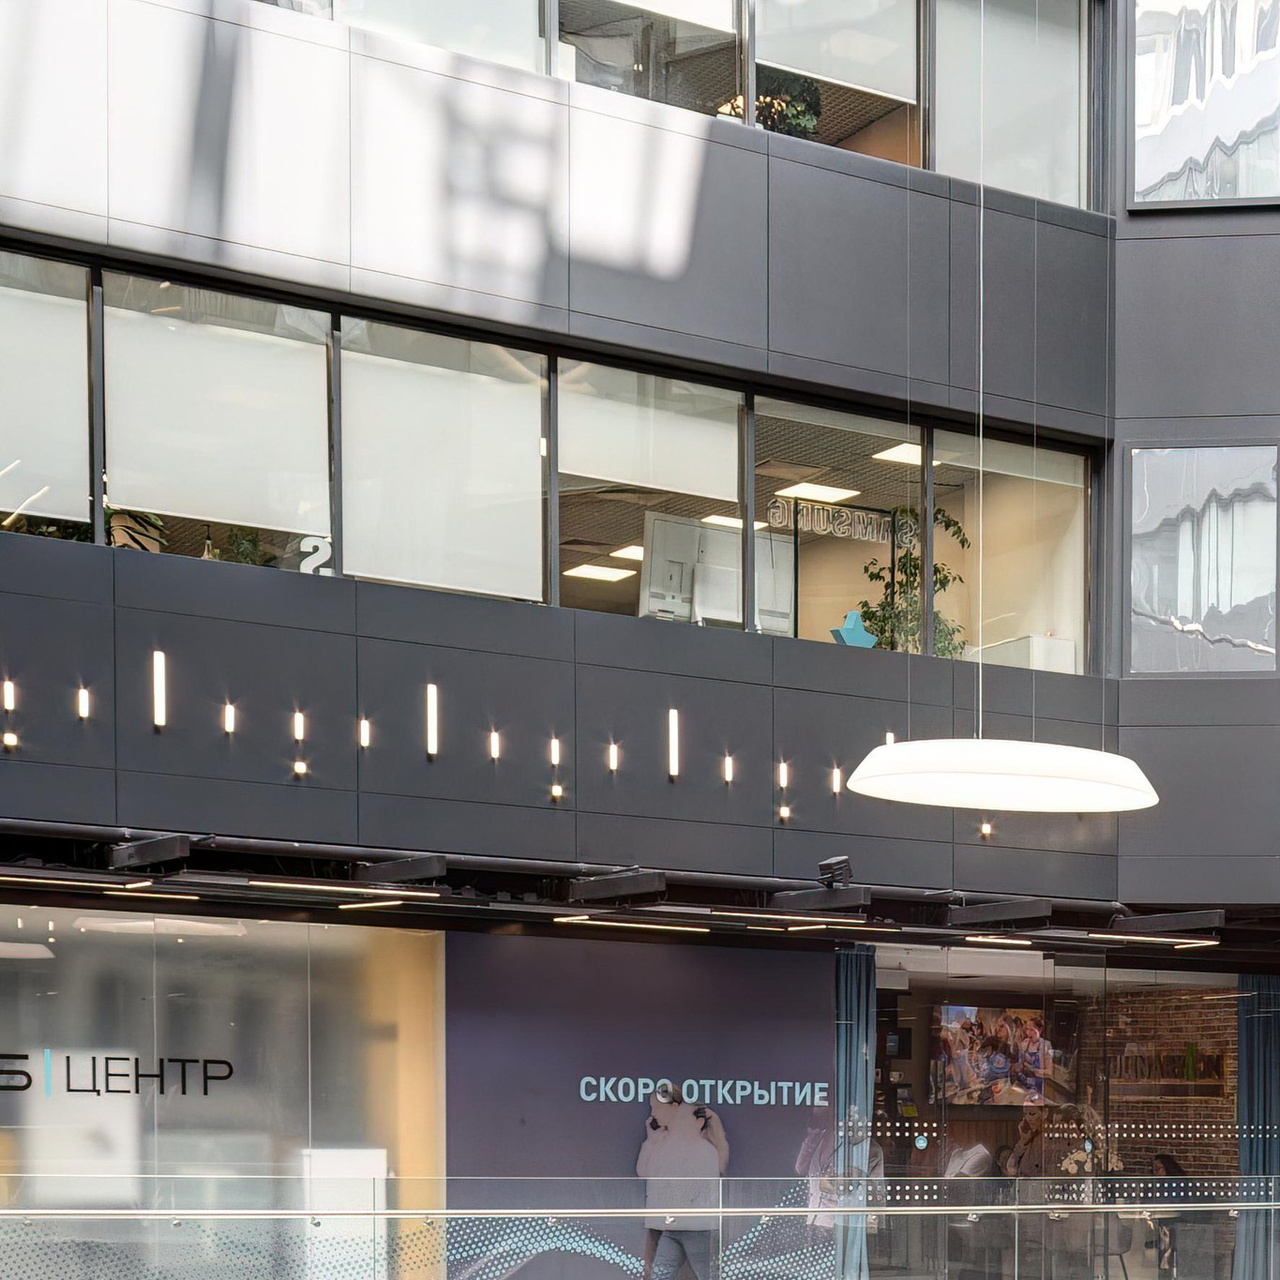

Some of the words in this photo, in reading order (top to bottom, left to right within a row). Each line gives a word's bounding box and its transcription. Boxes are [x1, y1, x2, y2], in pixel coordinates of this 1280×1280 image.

[66, 1055, 234, 1096] ЦЕНТР
[579, 1076, 674, 1104] СКОРО
[682, 1079, 829, 1106] ОТКРЫТИЕ
